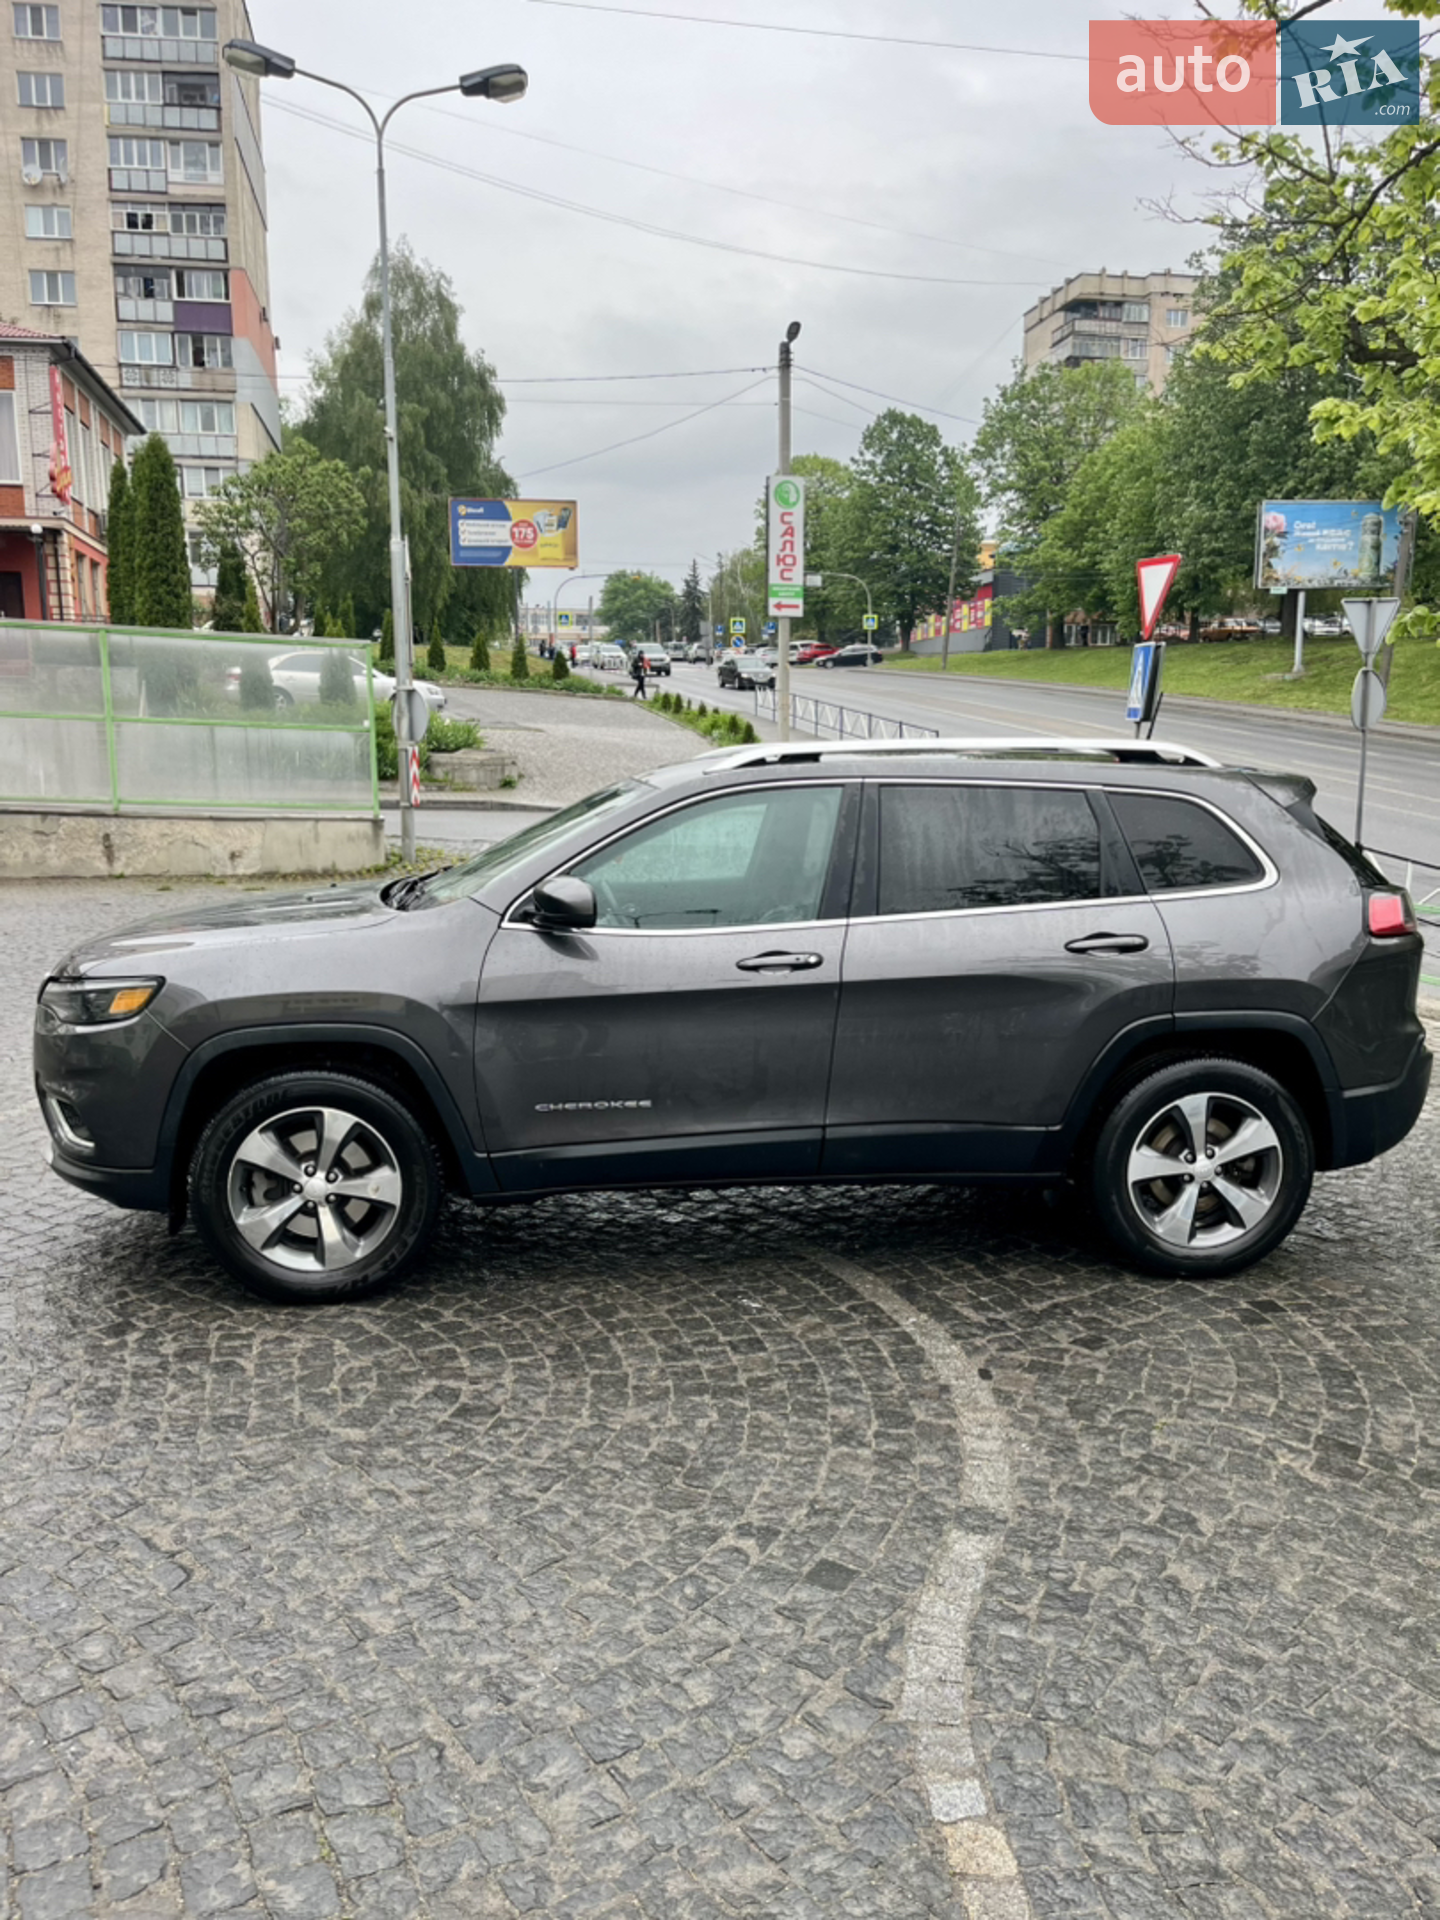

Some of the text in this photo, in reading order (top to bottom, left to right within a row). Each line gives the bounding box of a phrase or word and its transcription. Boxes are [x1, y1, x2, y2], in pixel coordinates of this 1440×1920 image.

[512, 527, 534, 539] 175
[776, 512, 797, 582] САЛЮС
[534, 1099, 652, 1112] CHEROKEE
